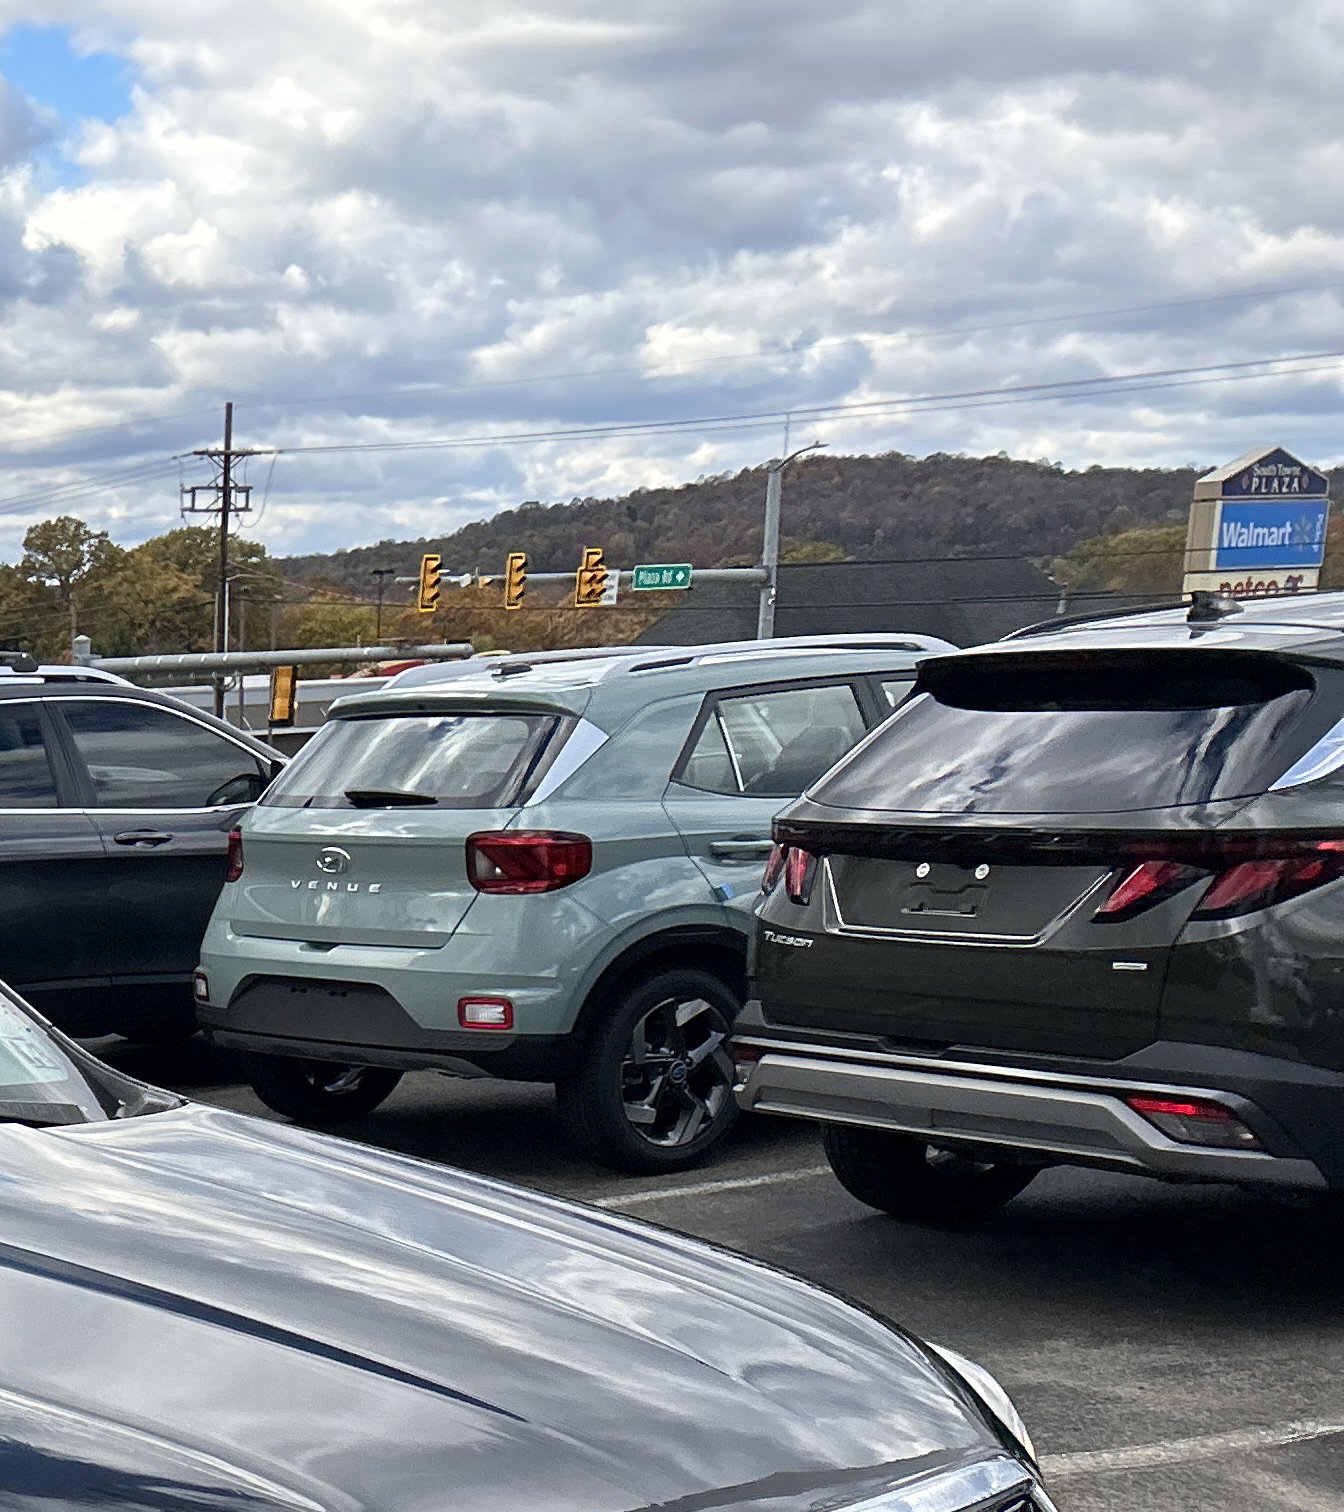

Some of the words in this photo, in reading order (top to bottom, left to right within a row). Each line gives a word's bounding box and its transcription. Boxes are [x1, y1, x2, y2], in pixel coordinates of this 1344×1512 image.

[1251, 477, 1300, 493] PLAZA
[1223, 520, 1292, 548] Walmart
[291, 880, 381, 893] VENUE
